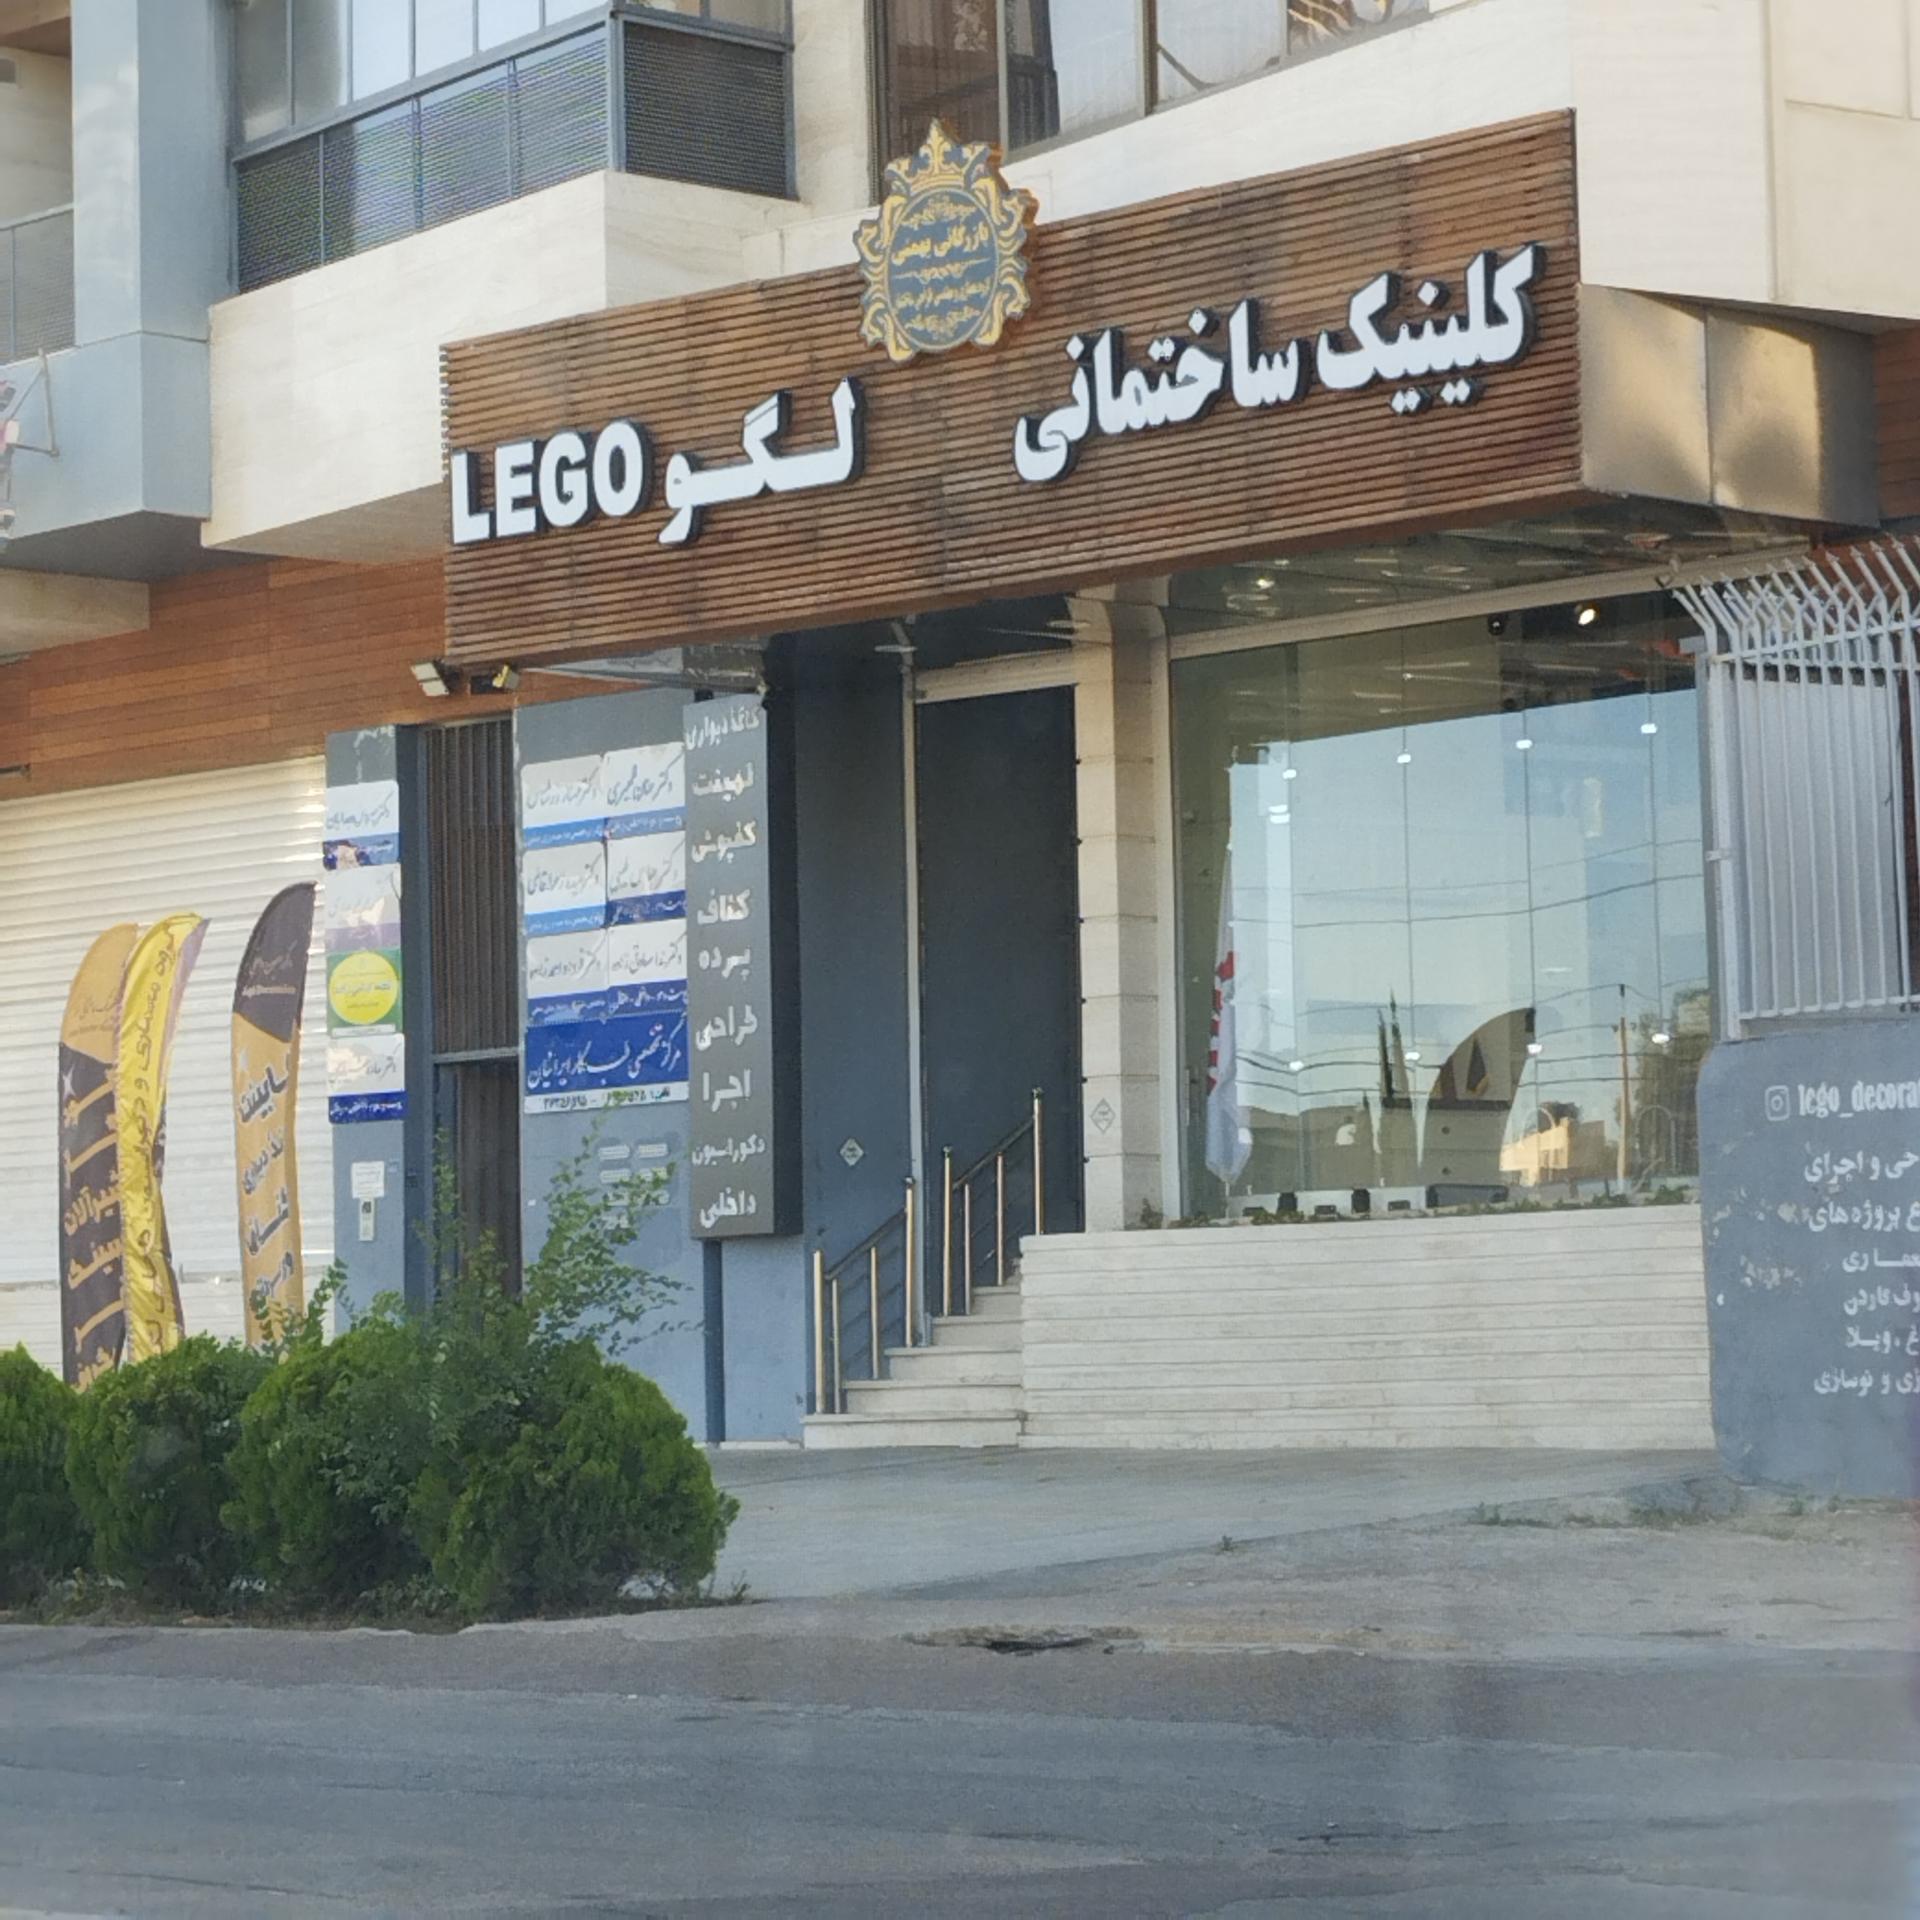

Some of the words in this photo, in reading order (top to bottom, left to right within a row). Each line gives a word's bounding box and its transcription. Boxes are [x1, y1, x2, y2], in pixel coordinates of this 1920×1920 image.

[1316, 244, 1538, 414] کلینیک
[1013, 299, 1300, 482] ساختمانی
[658, 376, 860, 545] لگو
[450, 418, 647, 546] LEGO
[684, 714, 728, 751] دیواری
[692, 761, 756, 803] لمینت
[691, 820, 757, 864] کفپوش
[697, 888, 751, 925] کناف
[698, 946, 751, 981] پرده
[695, 1004, 759, 1052] طراحی
[702, 1068, 751, 1113] اجرا
[1798, 1080, 1920, 1118] lego_decora
[691, 1133, 766, 1167] دکوراسیون
[1804, 1150, 1864, 1185] اجرای
[1868, 1155, 1881, 1181] و
[699, 1186, 757, 1230] داخلی
[1841, 1248, 1920, 1273] عماری
[1813, 1366, 1874, 1398] نوسازی
[1880, 1370, 1891, 1396] و
